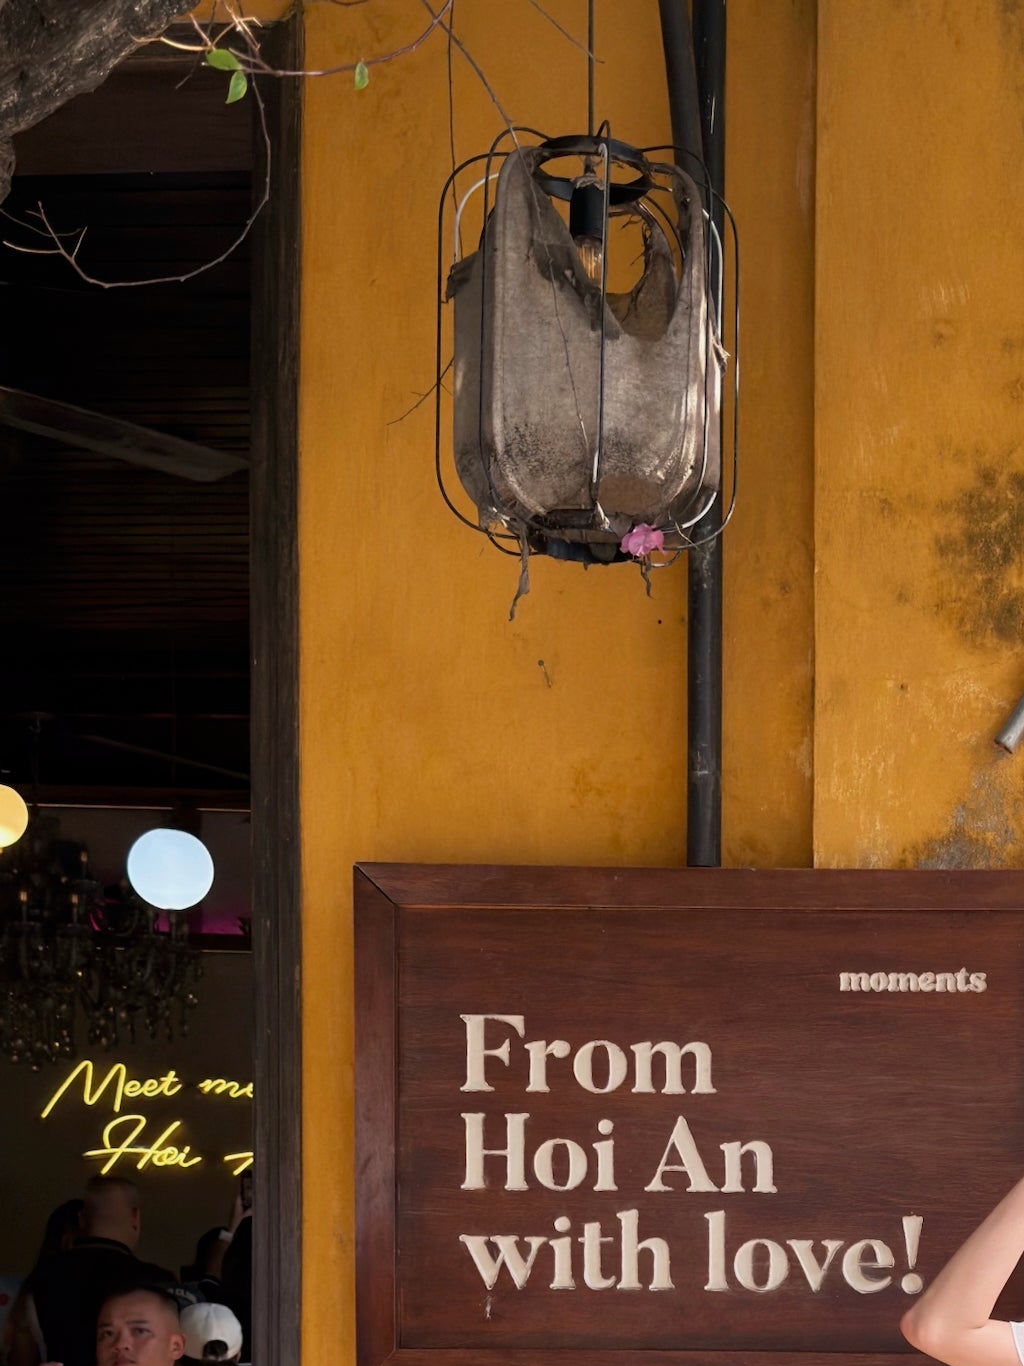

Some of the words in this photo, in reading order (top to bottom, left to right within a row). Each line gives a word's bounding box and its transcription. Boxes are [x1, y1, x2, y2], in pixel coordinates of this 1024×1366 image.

[839, 967, 988, 993] moments
[459, 1014, 717, 1094] From
[41, 1060, 183, 1119] Meet
[83, 1115, 202, 1175] Hoi
[460, 1112, 618, 1191] Hoi
[644, 1116, 778, 1193] An
[459, 1209, 675, 1292] with
[704, 1210, 925, 1294] love!
